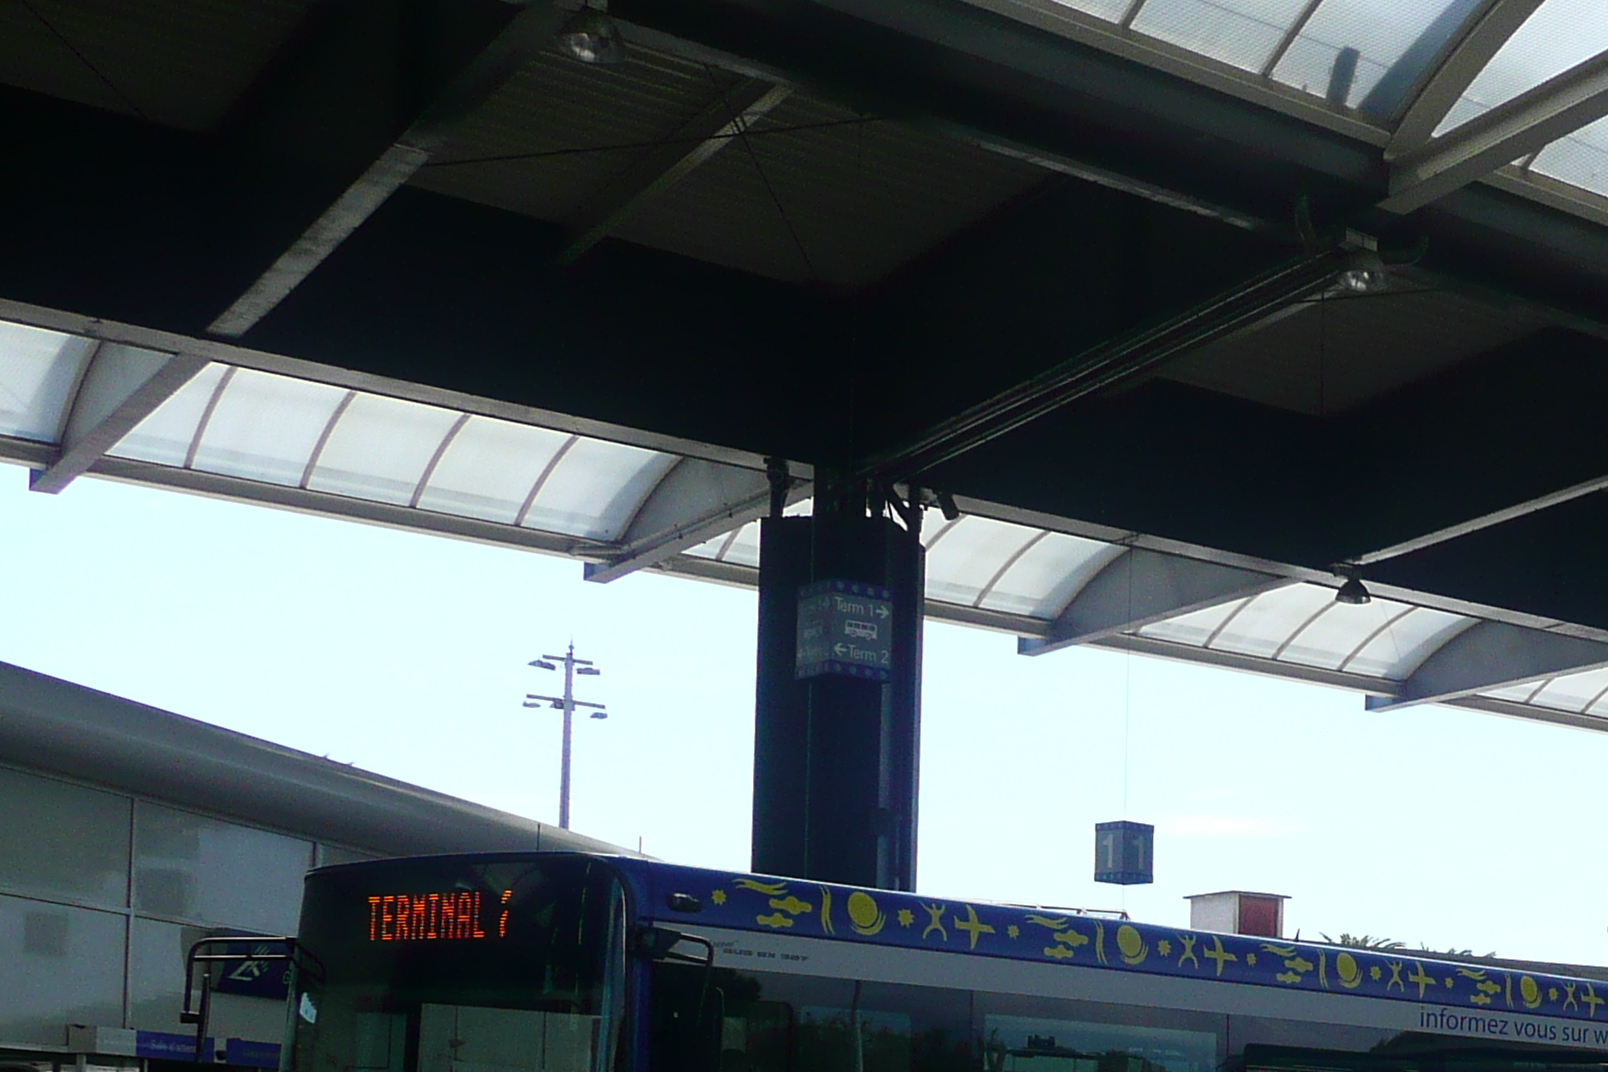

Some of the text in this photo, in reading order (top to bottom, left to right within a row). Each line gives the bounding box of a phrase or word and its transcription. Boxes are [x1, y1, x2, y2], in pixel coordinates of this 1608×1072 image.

[834, 596, 864, 615] Term
[865, 603, 874, 617] 1
[848, 644, 877, 662] Term
[880, 649, 889, 664] 2
[1102, 833, 1114, 868] 1
[1133, 835, 1145, 869] 1
[368, 890, 486, 940] TERMINAL
[1420, 1008, 1509, 1036] informez
[1513, 1018, 1557, 1042] vous
[1561, 1027, 1590, 1044] sur
